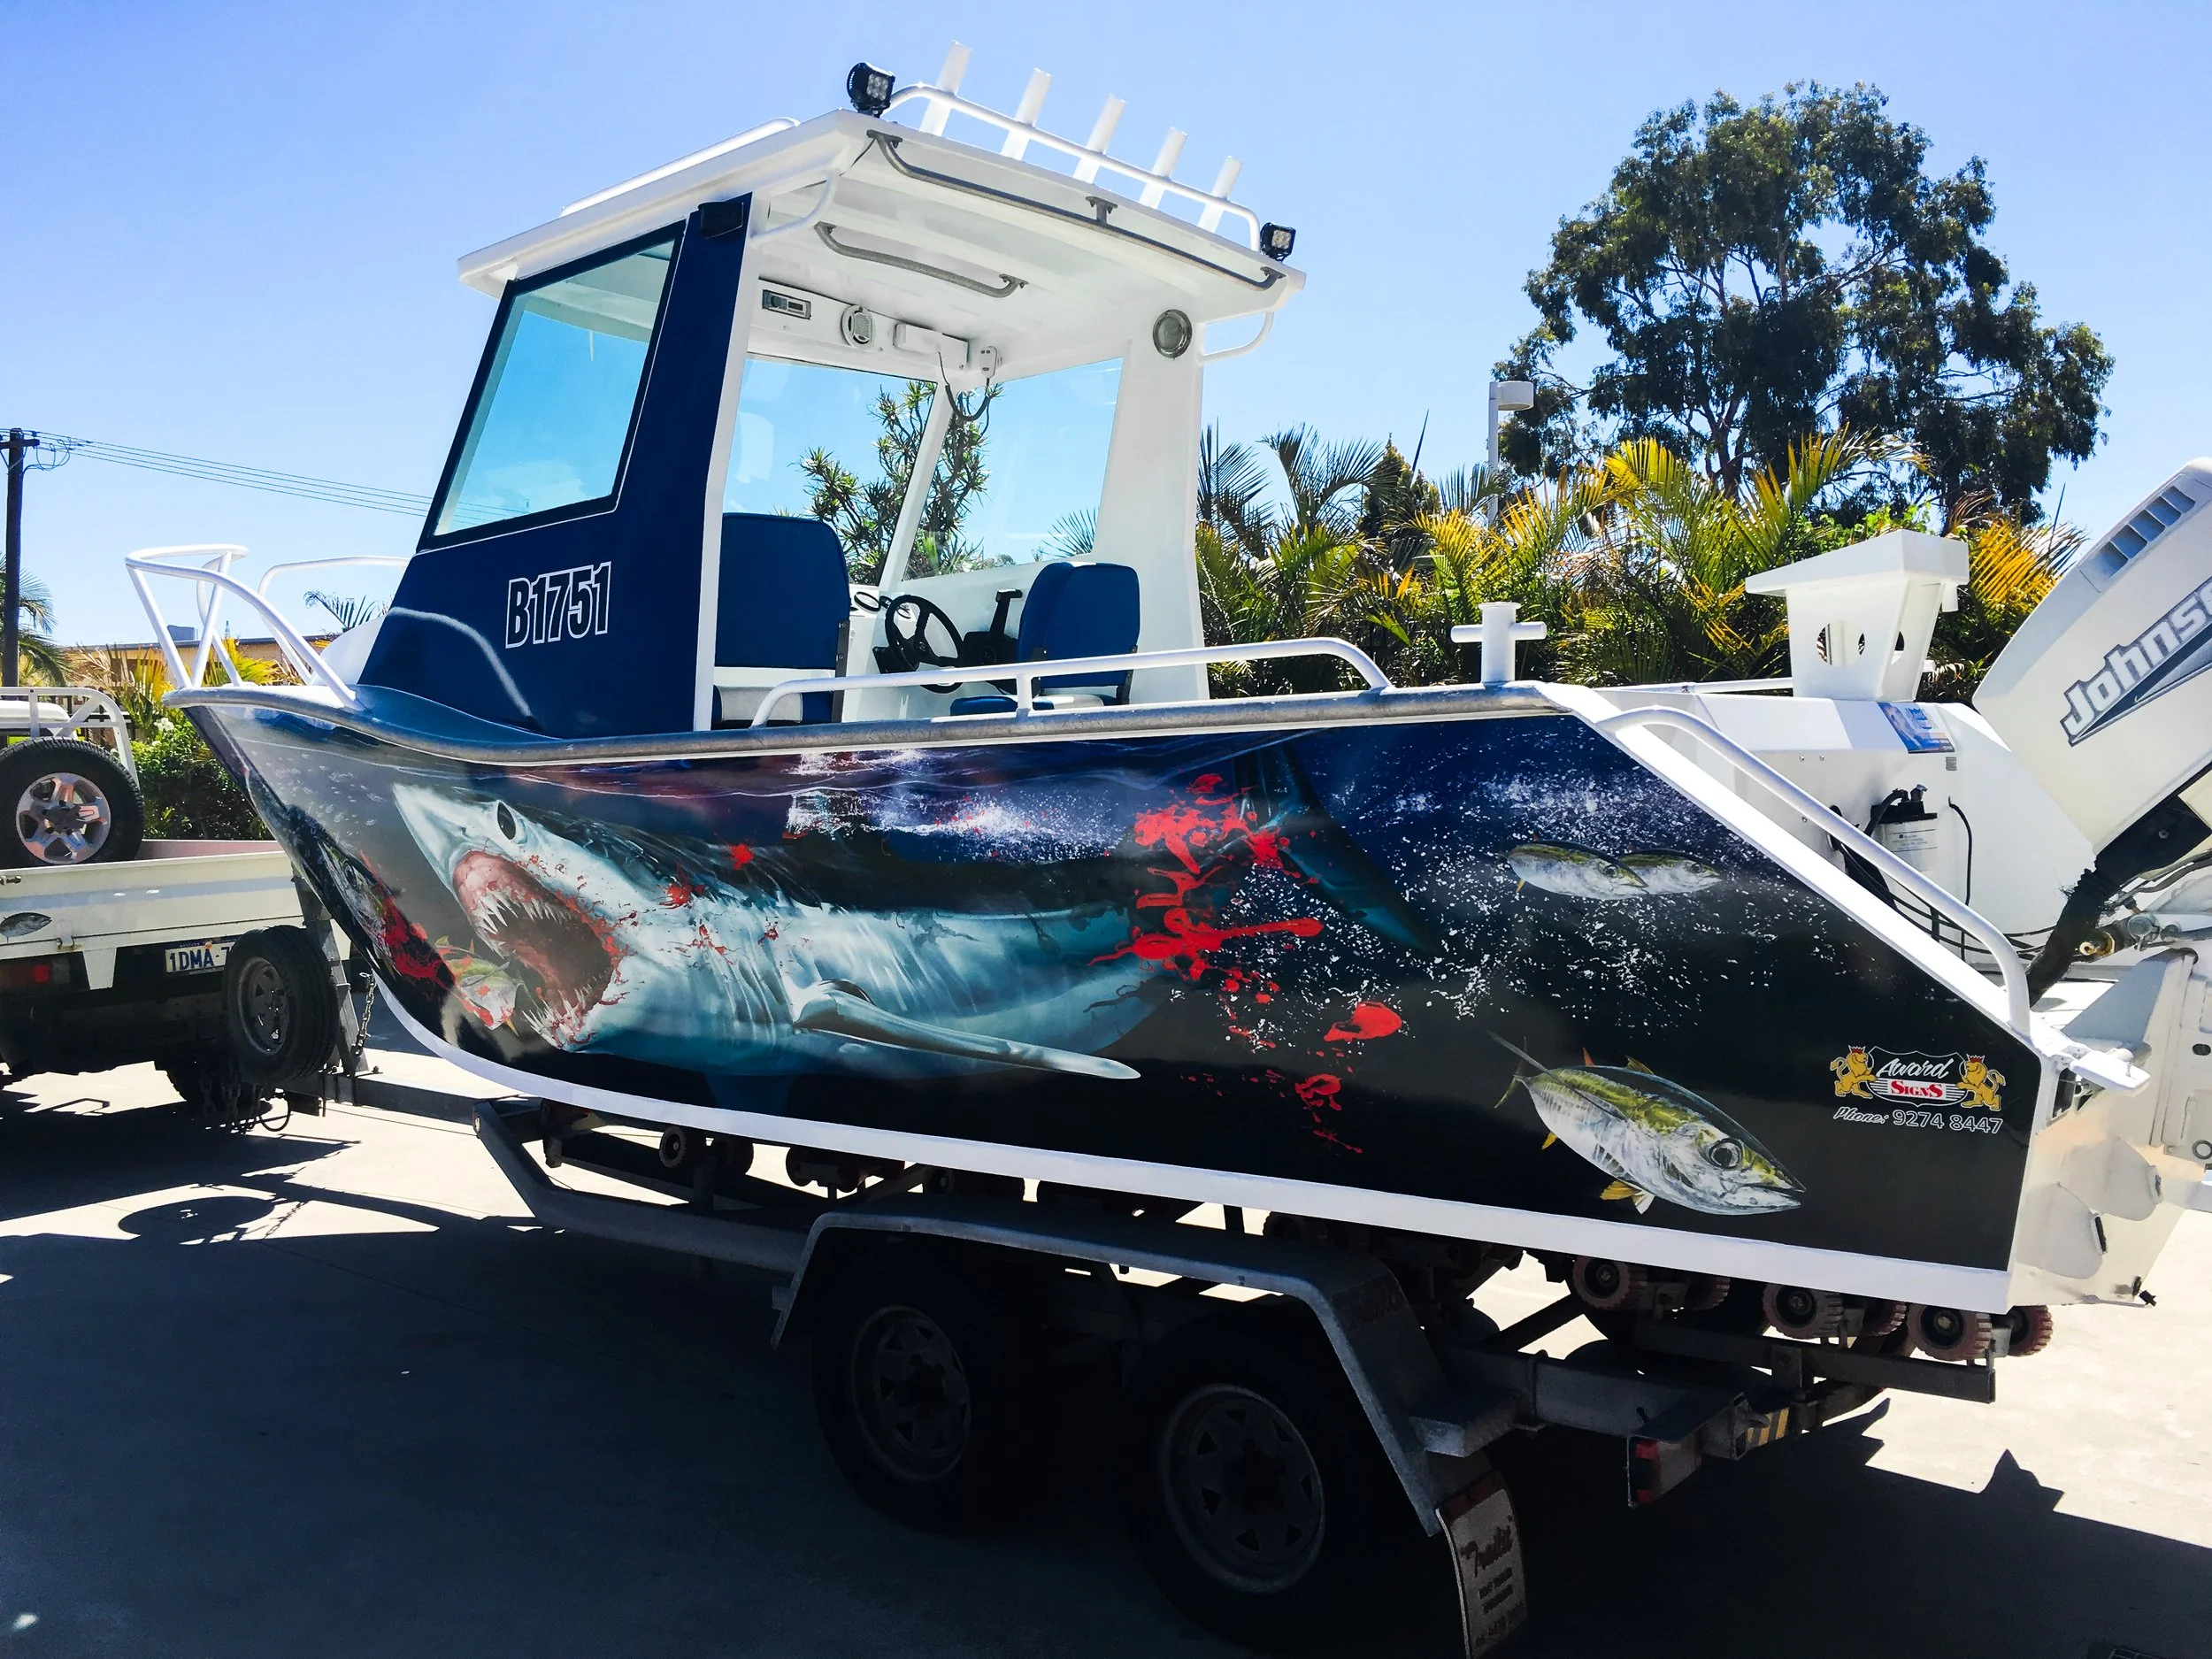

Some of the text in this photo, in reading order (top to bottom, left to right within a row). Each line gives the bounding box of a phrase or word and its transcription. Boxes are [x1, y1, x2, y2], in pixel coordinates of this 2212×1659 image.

[505, 561, 611, 649] B1751
[1876, 1057, 1954, 1079] Award
[1833, 1106, 2003, 1134] Phone: 9274 8447
